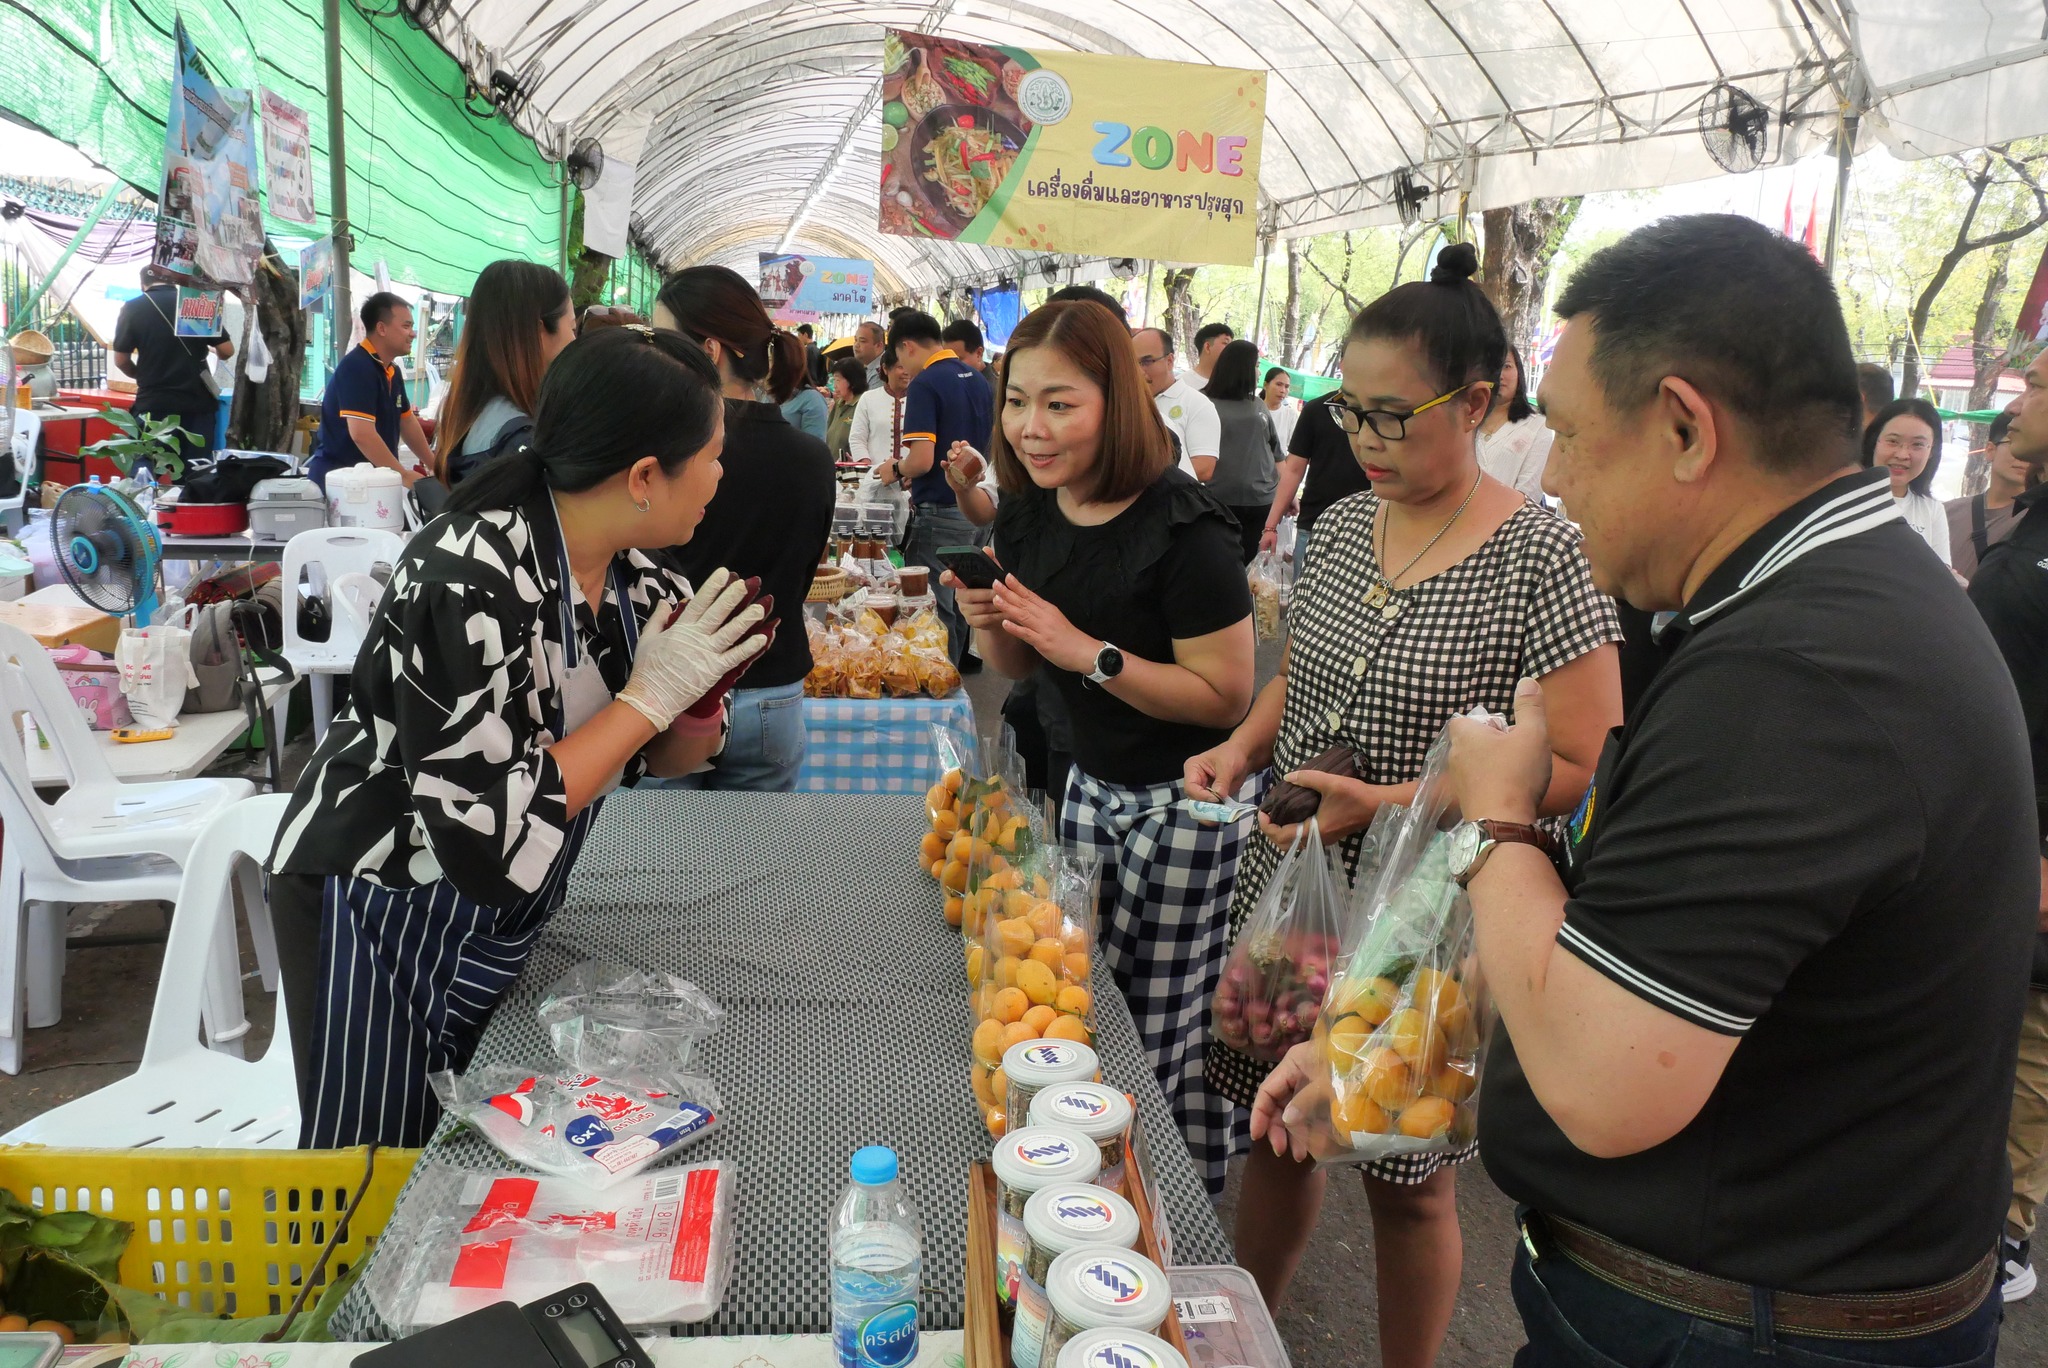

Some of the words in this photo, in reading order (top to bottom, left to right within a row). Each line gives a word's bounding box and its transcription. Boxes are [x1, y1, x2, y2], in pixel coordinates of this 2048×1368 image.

[1092, 120, 1247, 176] ZONE
[1028, 168, 1244, 222] เครื่องดื่มและอาหารปรุงสุก
[820, 271, 868, 286] ZONE
[832, 288, 867, 303] ภาคใต้
[571, 1120, 610, 1145] 6x14
